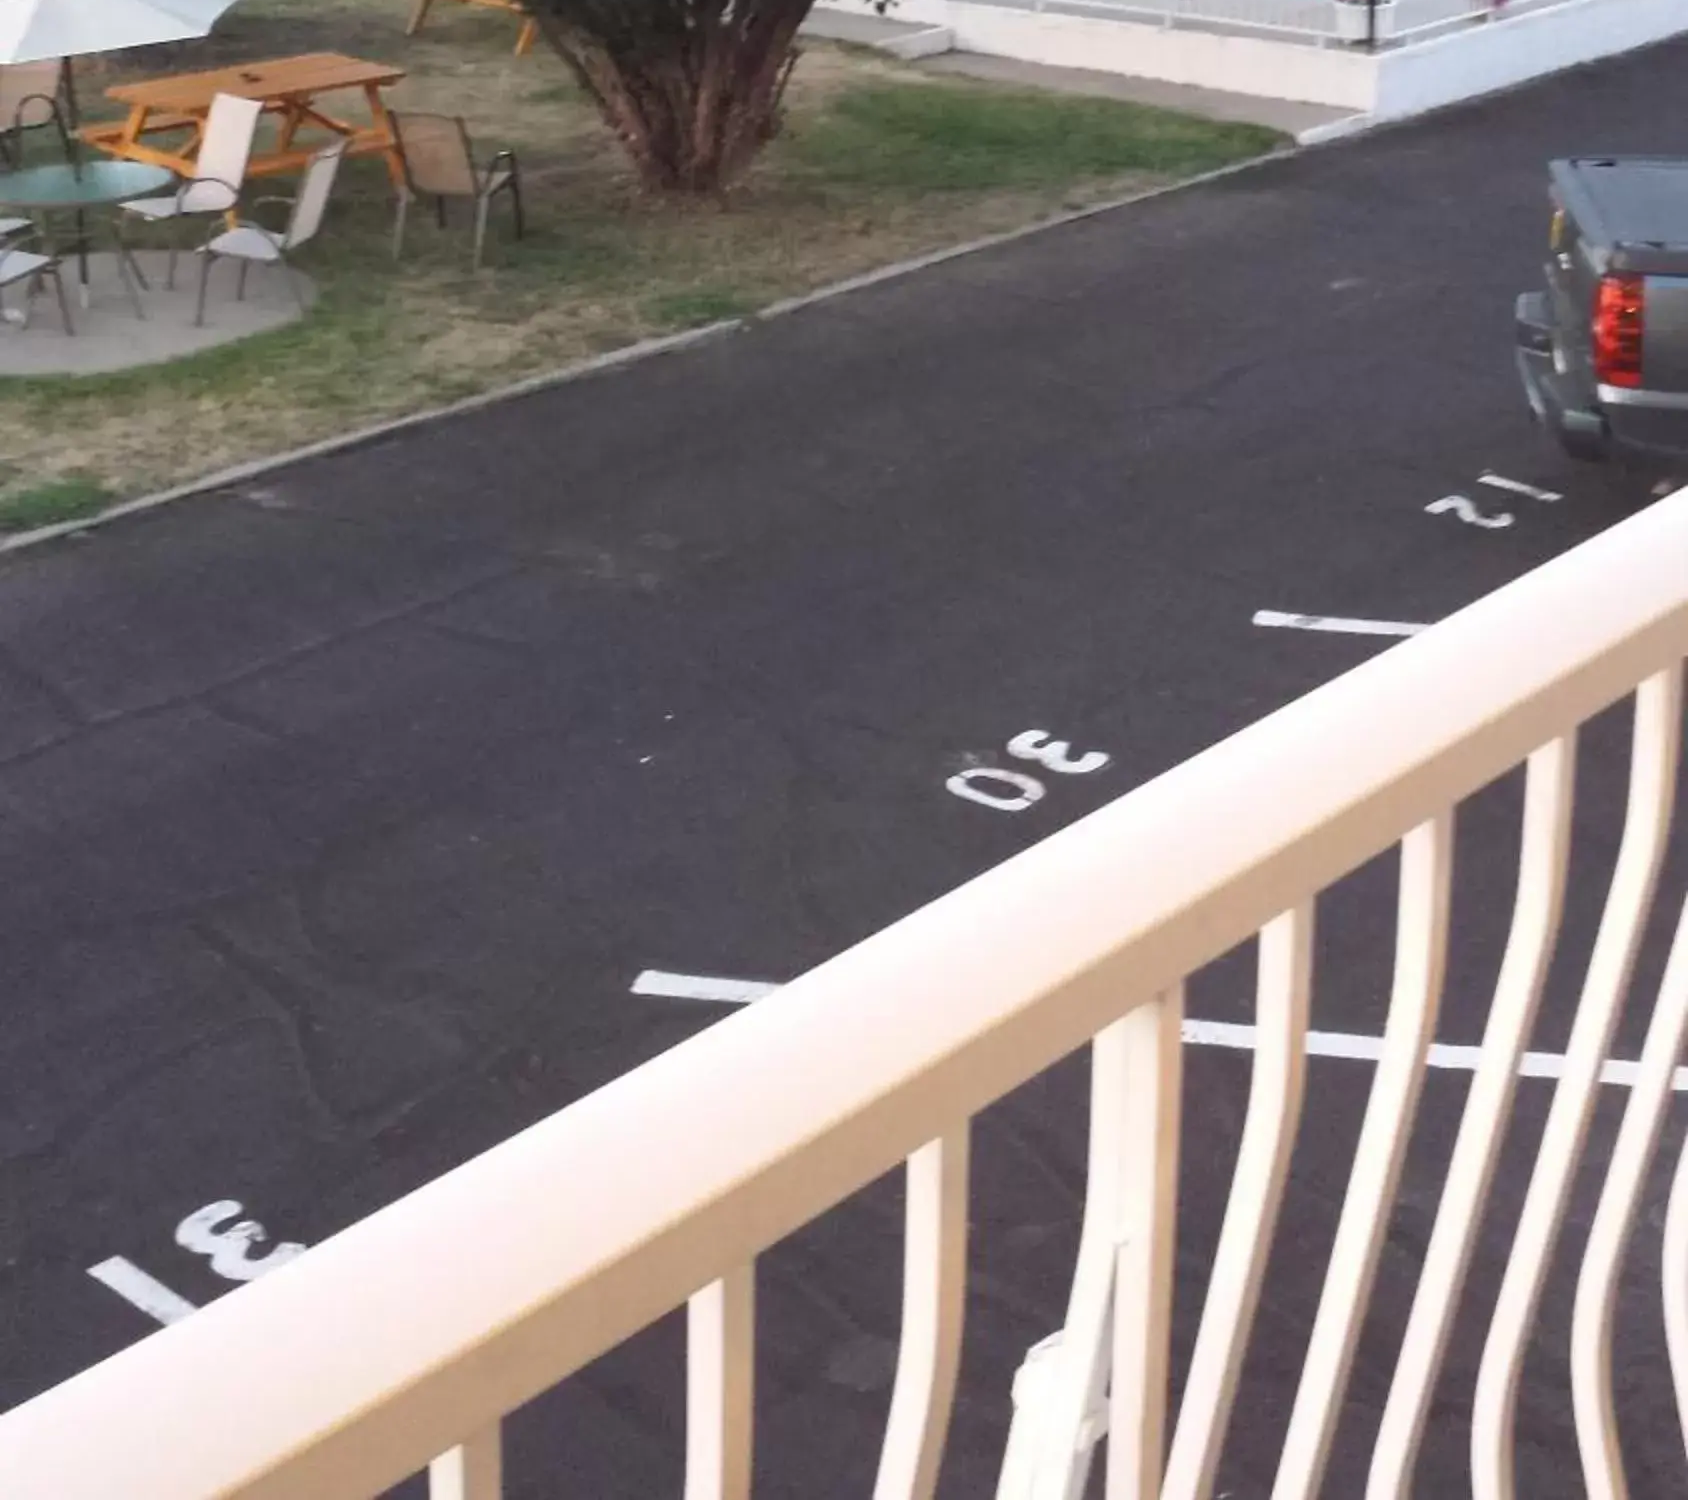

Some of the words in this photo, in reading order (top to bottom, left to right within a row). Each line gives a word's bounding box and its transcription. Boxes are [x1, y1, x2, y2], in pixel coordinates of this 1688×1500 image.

[1424, 470, 1563, 528] 12
[946, 728, 1110, 811] 30
[86, 1199, 308, 1326] 31
